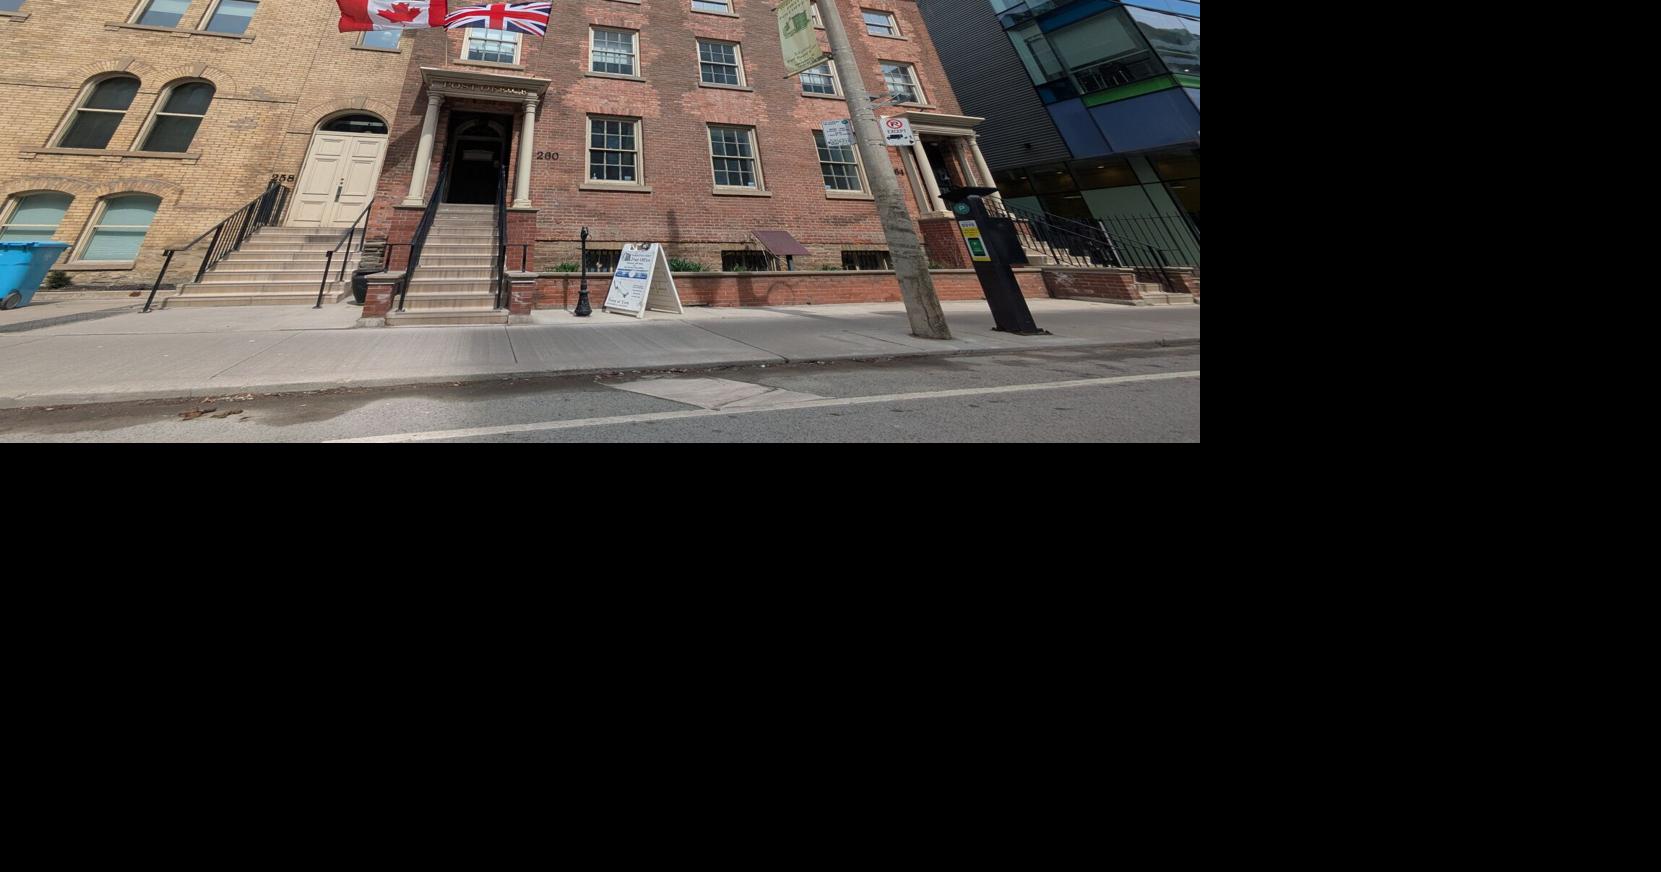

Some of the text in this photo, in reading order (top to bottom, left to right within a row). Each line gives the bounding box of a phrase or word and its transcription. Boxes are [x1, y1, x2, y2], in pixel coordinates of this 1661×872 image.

[536, 151, 560, 161] 260
[893, 166, 904, 176] 64
[270, 173, 295, 183] 258
